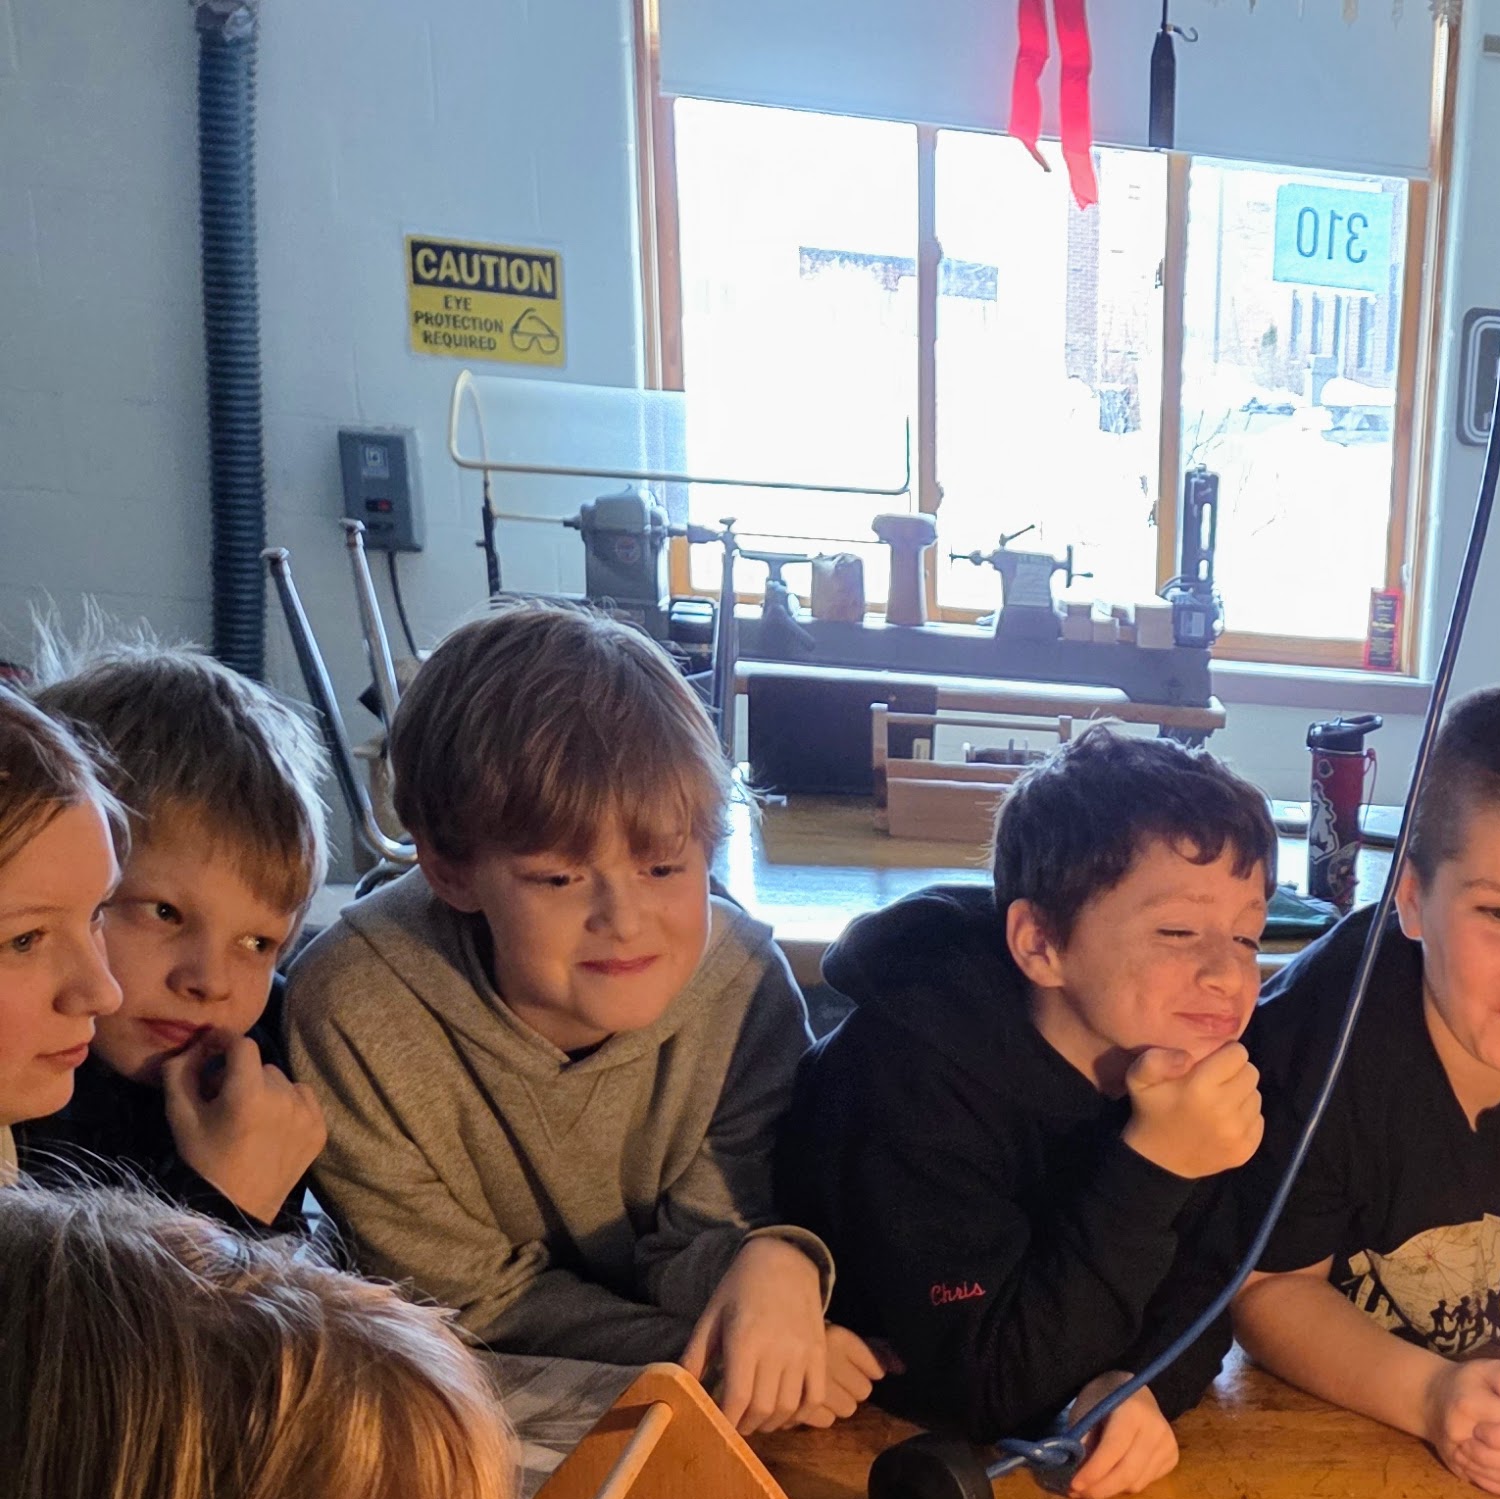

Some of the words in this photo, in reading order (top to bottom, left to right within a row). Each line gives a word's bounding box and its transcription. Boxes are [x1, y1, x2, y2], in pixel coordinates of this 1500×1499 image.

[414, 247, 554, 293] CAUTION
[443, 294, 473, 312] EYE
[413, 310, 505, 333] PROTECTION
[421, 329, 498, 351] REQUIRED
